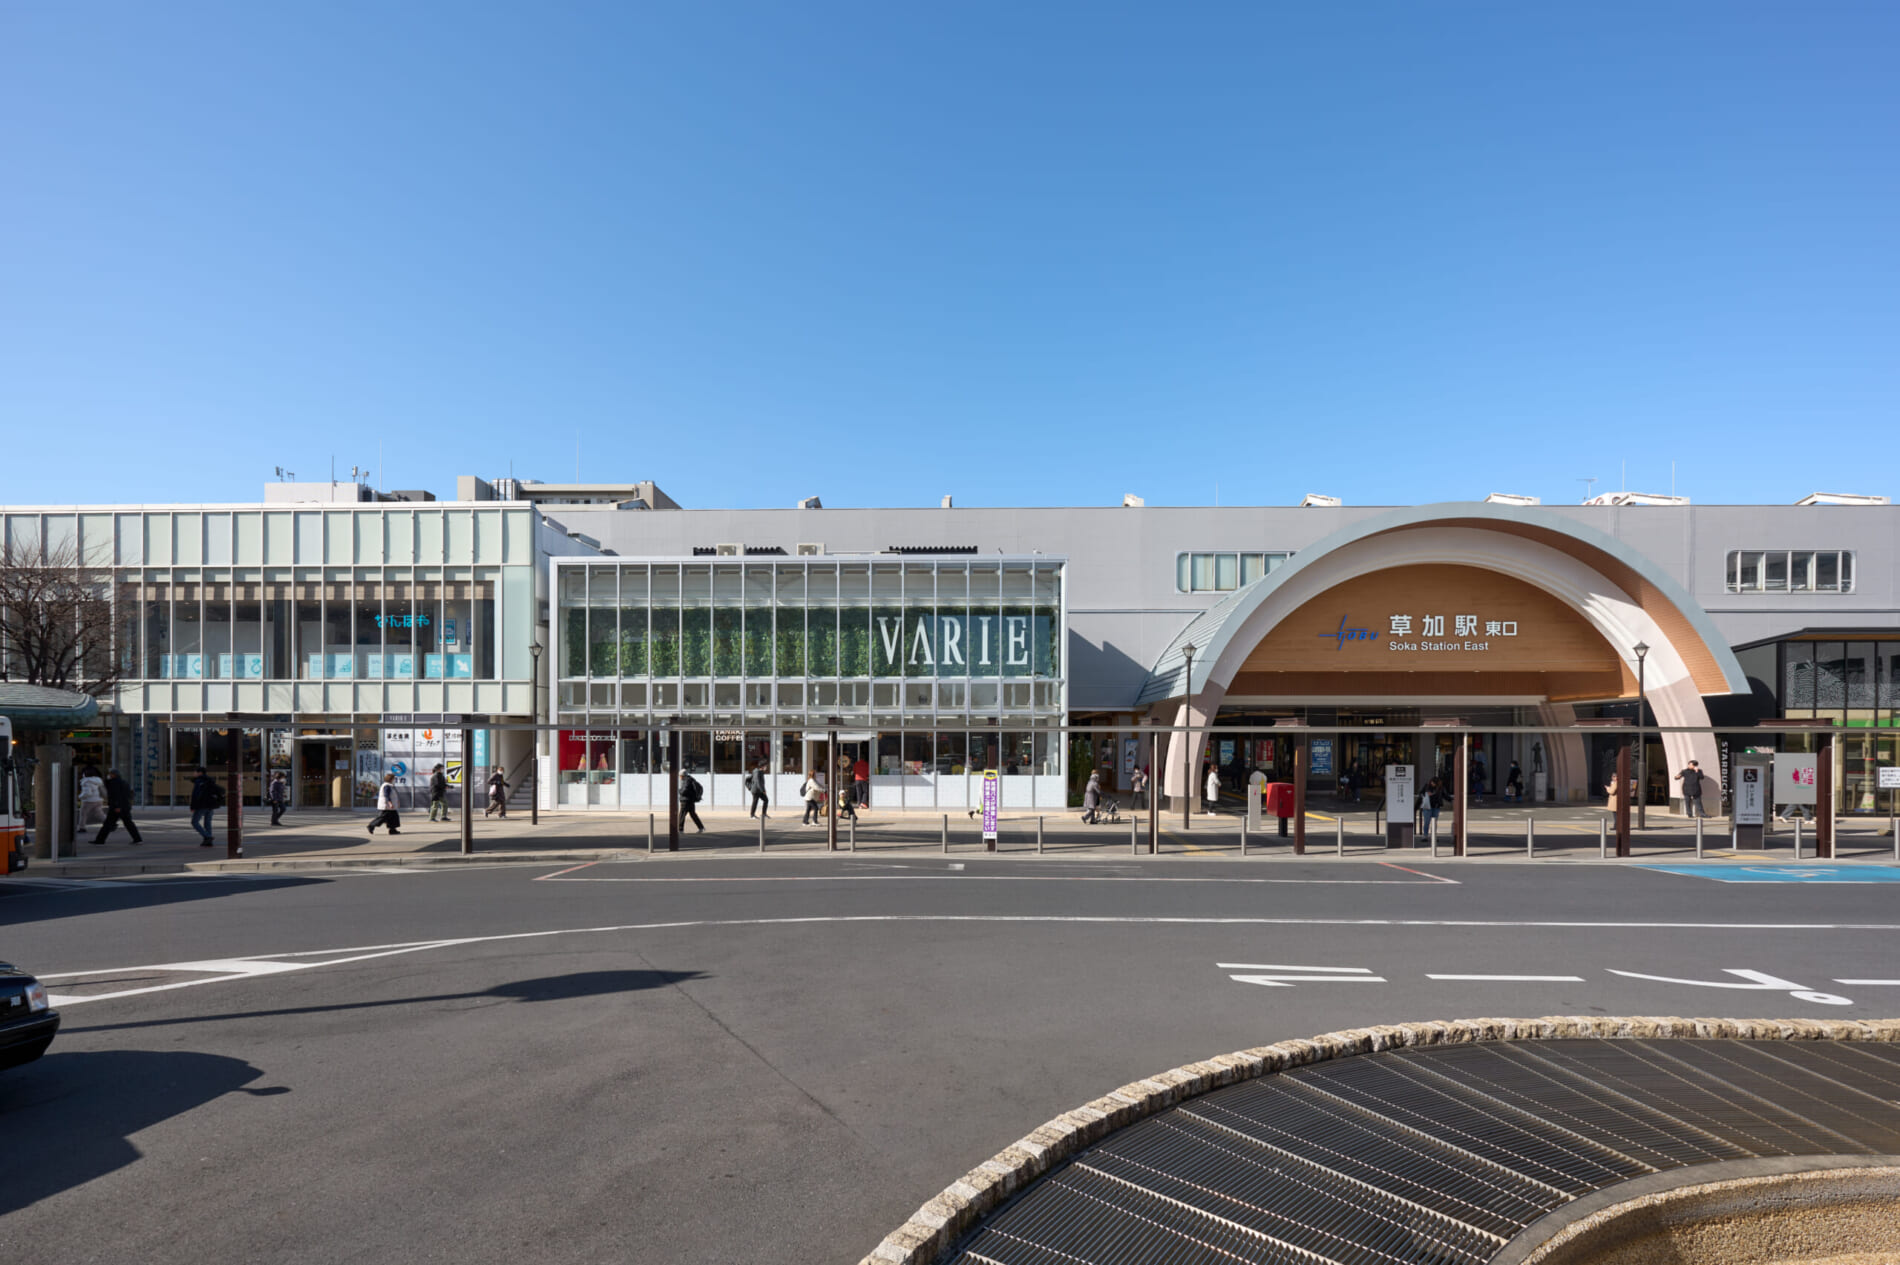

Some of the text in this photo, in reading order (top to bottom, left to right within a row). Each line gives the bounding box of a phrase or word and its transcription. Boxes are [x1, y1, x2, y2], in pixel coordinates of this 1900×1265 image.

[374, 614, 430, 628] なんぼや
[1389, 615, 1518, 637] 草加駅 東口
[877, 616, 1028, 665] VARIE
[1389, 641, 1489, 651] Soka Station East
[1720, 741, 1729, 802] STARBUCKS
